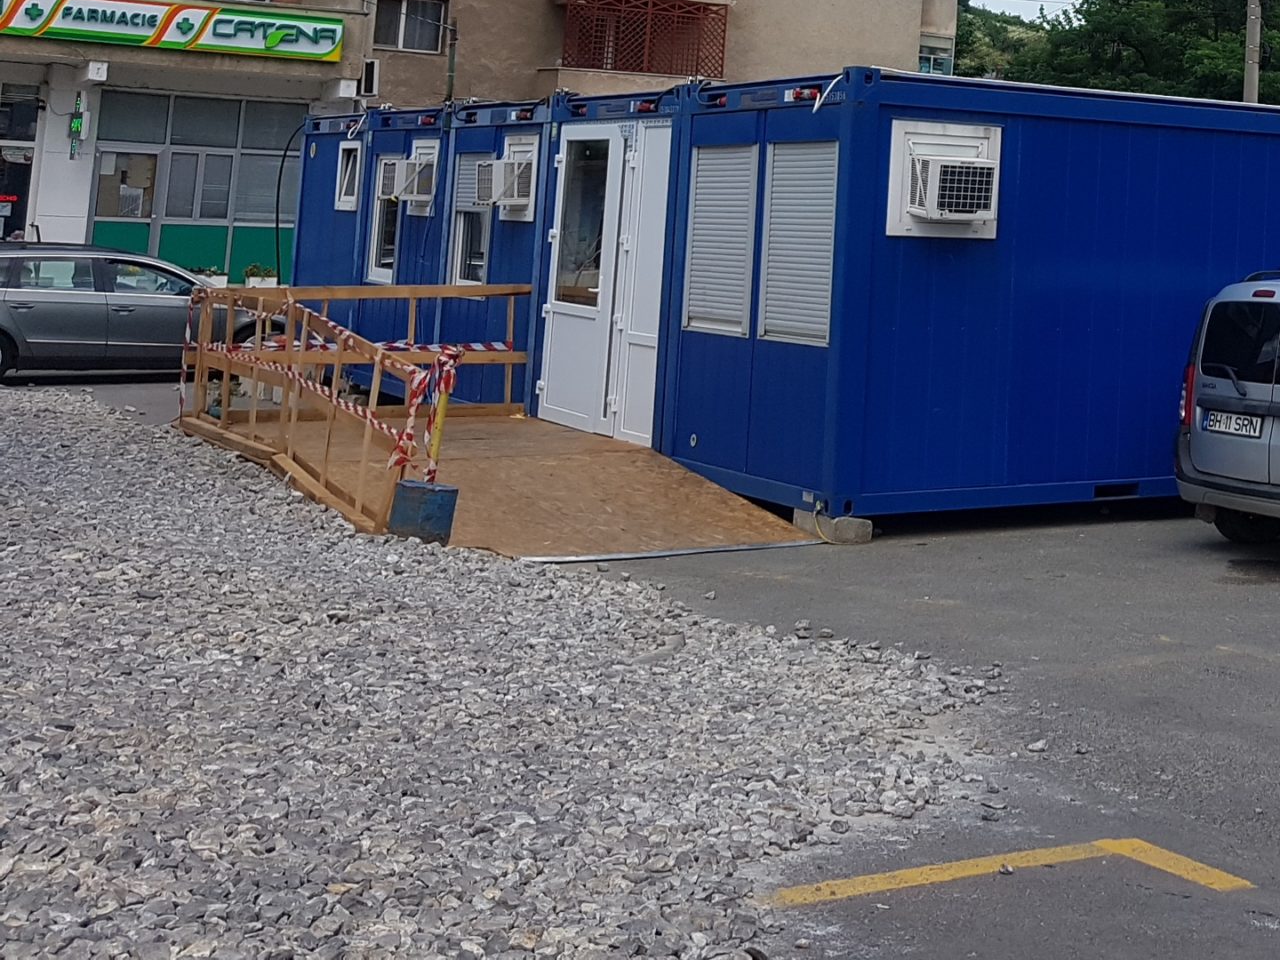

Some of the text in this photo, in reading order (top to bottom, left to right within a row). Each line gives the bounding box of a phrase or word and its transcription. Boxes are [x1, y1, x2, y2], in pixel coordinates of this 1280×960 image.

[61, 6, 158, 28] FARMACIE
[1208, 413, 1258, 434] BH 11 SRN
